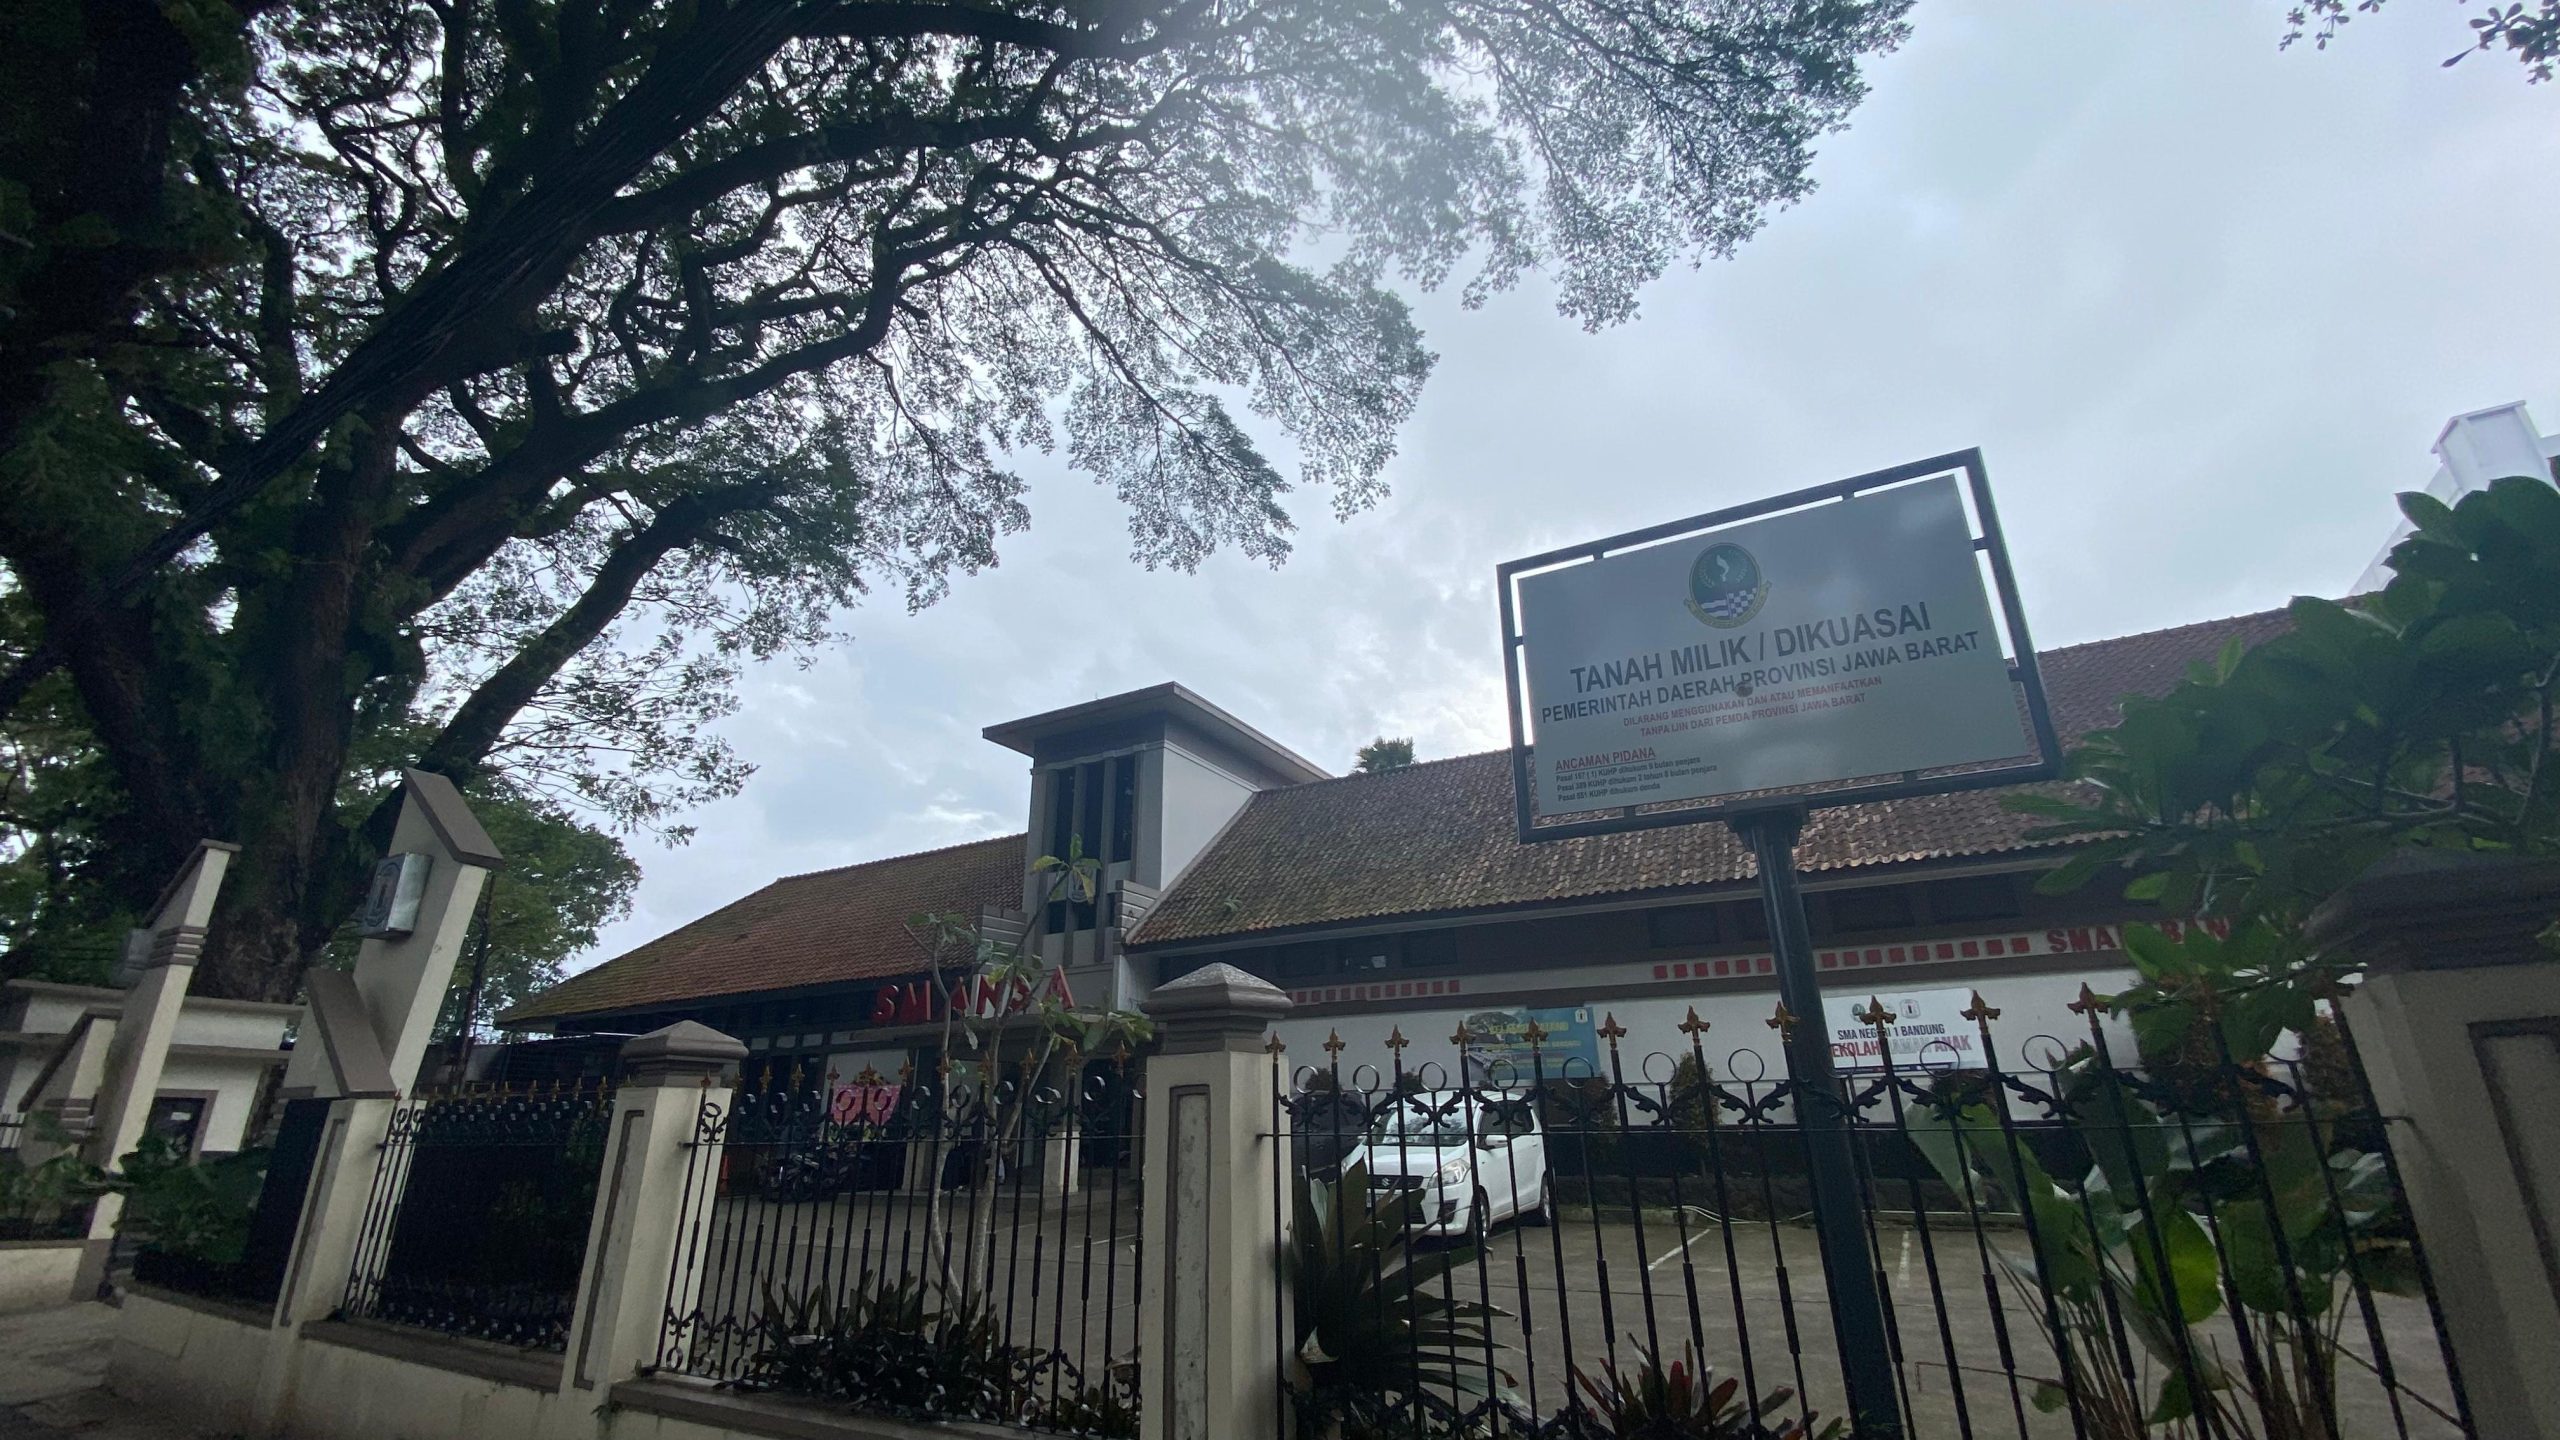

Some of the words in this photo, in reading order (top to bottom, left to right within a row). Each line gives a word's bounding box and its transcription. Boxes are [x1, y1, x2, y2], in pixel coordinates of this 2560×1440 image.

[1570, 653, 1663, 693] TANAH
[1671, 630, 1752, 676] MILIK
[1759, 631, 1765, 662] /
[1774, 601, 1932, 657] DIKUASAI
[1542, 690, 1651, 723] PEMERINTAH
[1657, 675, 1735, 704] DAERAH
[1741, 656, 1836, 688] PROVINSI
[1842, 645, 1900, 672] JAWA
[1905, 631, 1979, 661] BARAT
[1623, 711, 1669, 727] DILARANG
[1671, 700, 1745, 719] MENGGUNAKAN
[1747, 695, 1768, 708] DAN
[1769, 689, 1795, 703] ATAU
[1797, 675, 1882, 699] MEMANFAATKAN
[1640, 724, 1670, 738] TANPA
[1691, 717, 1714, 731] DARI
[1716, 711, 1750, 726] PEMDA
[1752, 704, 1799, 722] PROVINSI
[1801, 698, 1830, 712] JAWA
[1831, 692, 1866, 708] BARAT
[1555, 754, 1610, 771] ANCAMAN
[1613, 747, 1656, 764] PIDANA
[1588, 779, 1607, 788] KUHP
[1599, 767, 1617, 777] KUHP
[1589, 788, 1608, 798] KUHP
[2046, 923, 2124, 953] SMA
[1838, 1028, 1857, 1041] SMA
[1859, 1025, 1891, 1039] NEGRI
[1901, 1024, 1945, 1037] BANDUNG
[1831, 1040, 1881, 1058] EKOLAH
[1935, 1034, 1972, 1053] ANAK
